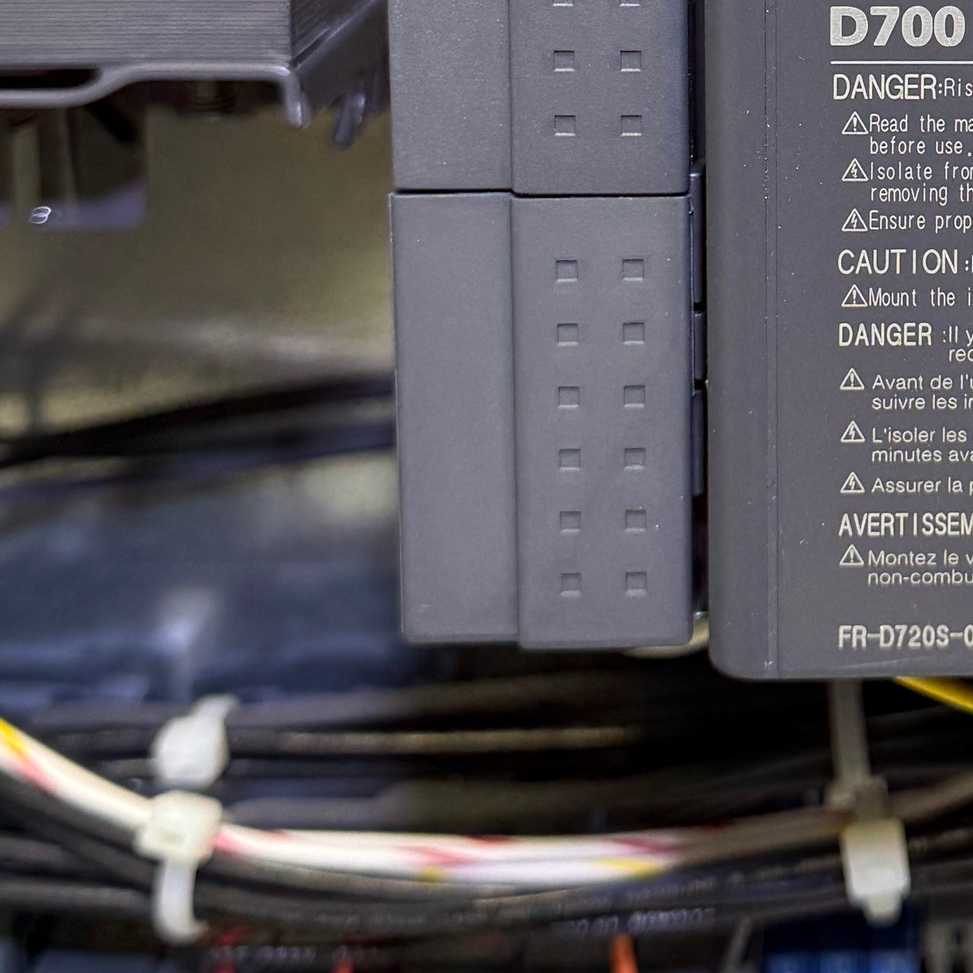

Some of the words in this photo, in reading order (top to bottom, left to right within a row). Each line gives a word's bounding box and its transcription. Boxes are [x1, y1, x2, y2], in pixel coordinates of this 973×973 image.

[829, 5, 966, 47] D700
[869, 113, 908, 133] Read
[919, 113, 946, 133] the
[869, 135, 926, 155] before
[935, 140, 972, 157] use.
[870, 161, 933, 181] Isolate
[870, 182, 948, 207] removing
[868, 209, 926, 231] Ensure
[837, 248, 958, 275] CAUTION
[868, 287, 917, 307] Mount
[930, 286, 956, 307] the
[838, 322, 932, 347] DANGER
[871, 374, 924, 391] Avant
[929, 374, 953, 390] de
[871, 393, 926, 411] suivre
[932, 393, 958, 410] les
[872, 426, 936, 444] L'isoler
[942, 426, 967, 443] les
[871, 447, 943, 463] minutes
[871, 477, 942, 494] Assurer
[947, 476, 963, 494] la
[868, 549, 937, 567] Montez
[943, 549, 960, 566] le
